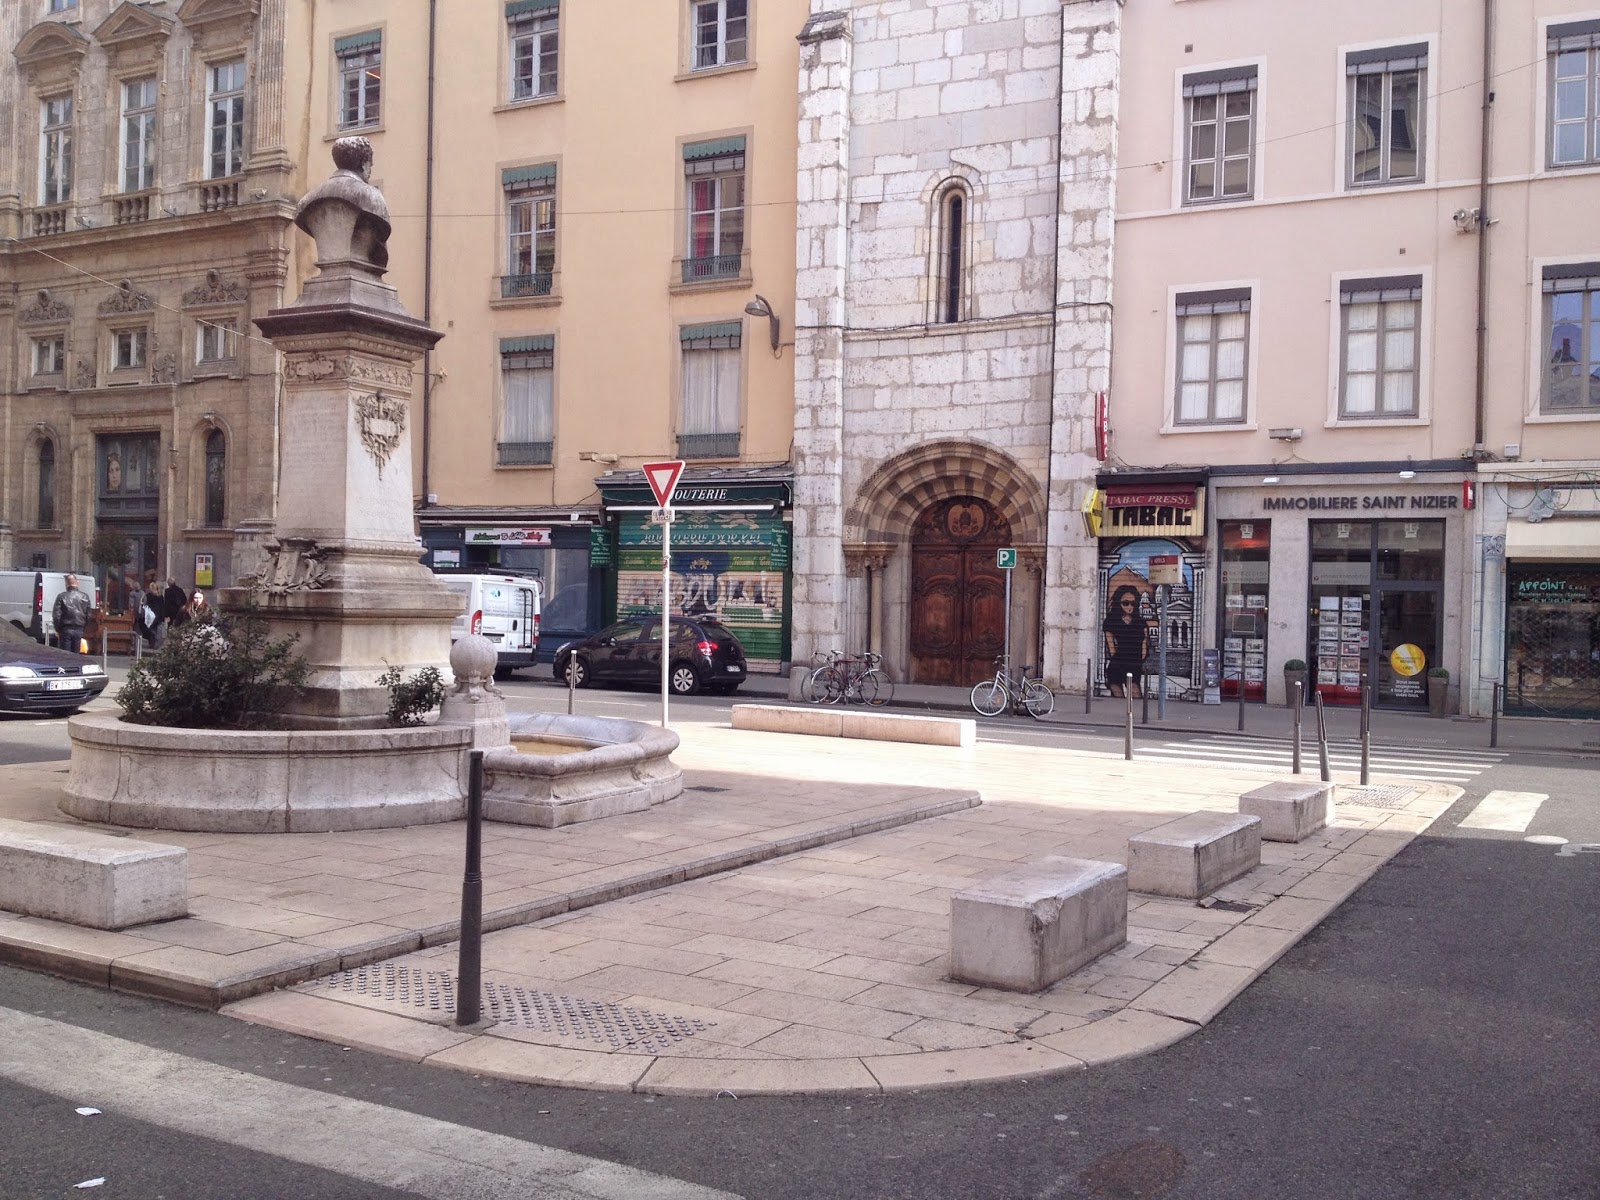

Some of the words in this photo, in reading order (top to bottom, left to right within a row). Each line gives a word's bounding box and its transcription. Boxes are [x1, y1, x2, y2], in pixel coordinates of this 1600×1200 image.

[1108, 495, 1145, 505] TABAC
[1263, 496, 1358, 510] IMMOBILIERE
[1362, 495, 1407, 509] SAINT
[1410, 495, 1458, 509] NIZIER
[1109, 506, 1192, 526] TABAC
[1000, 550, 1010, 565] P
